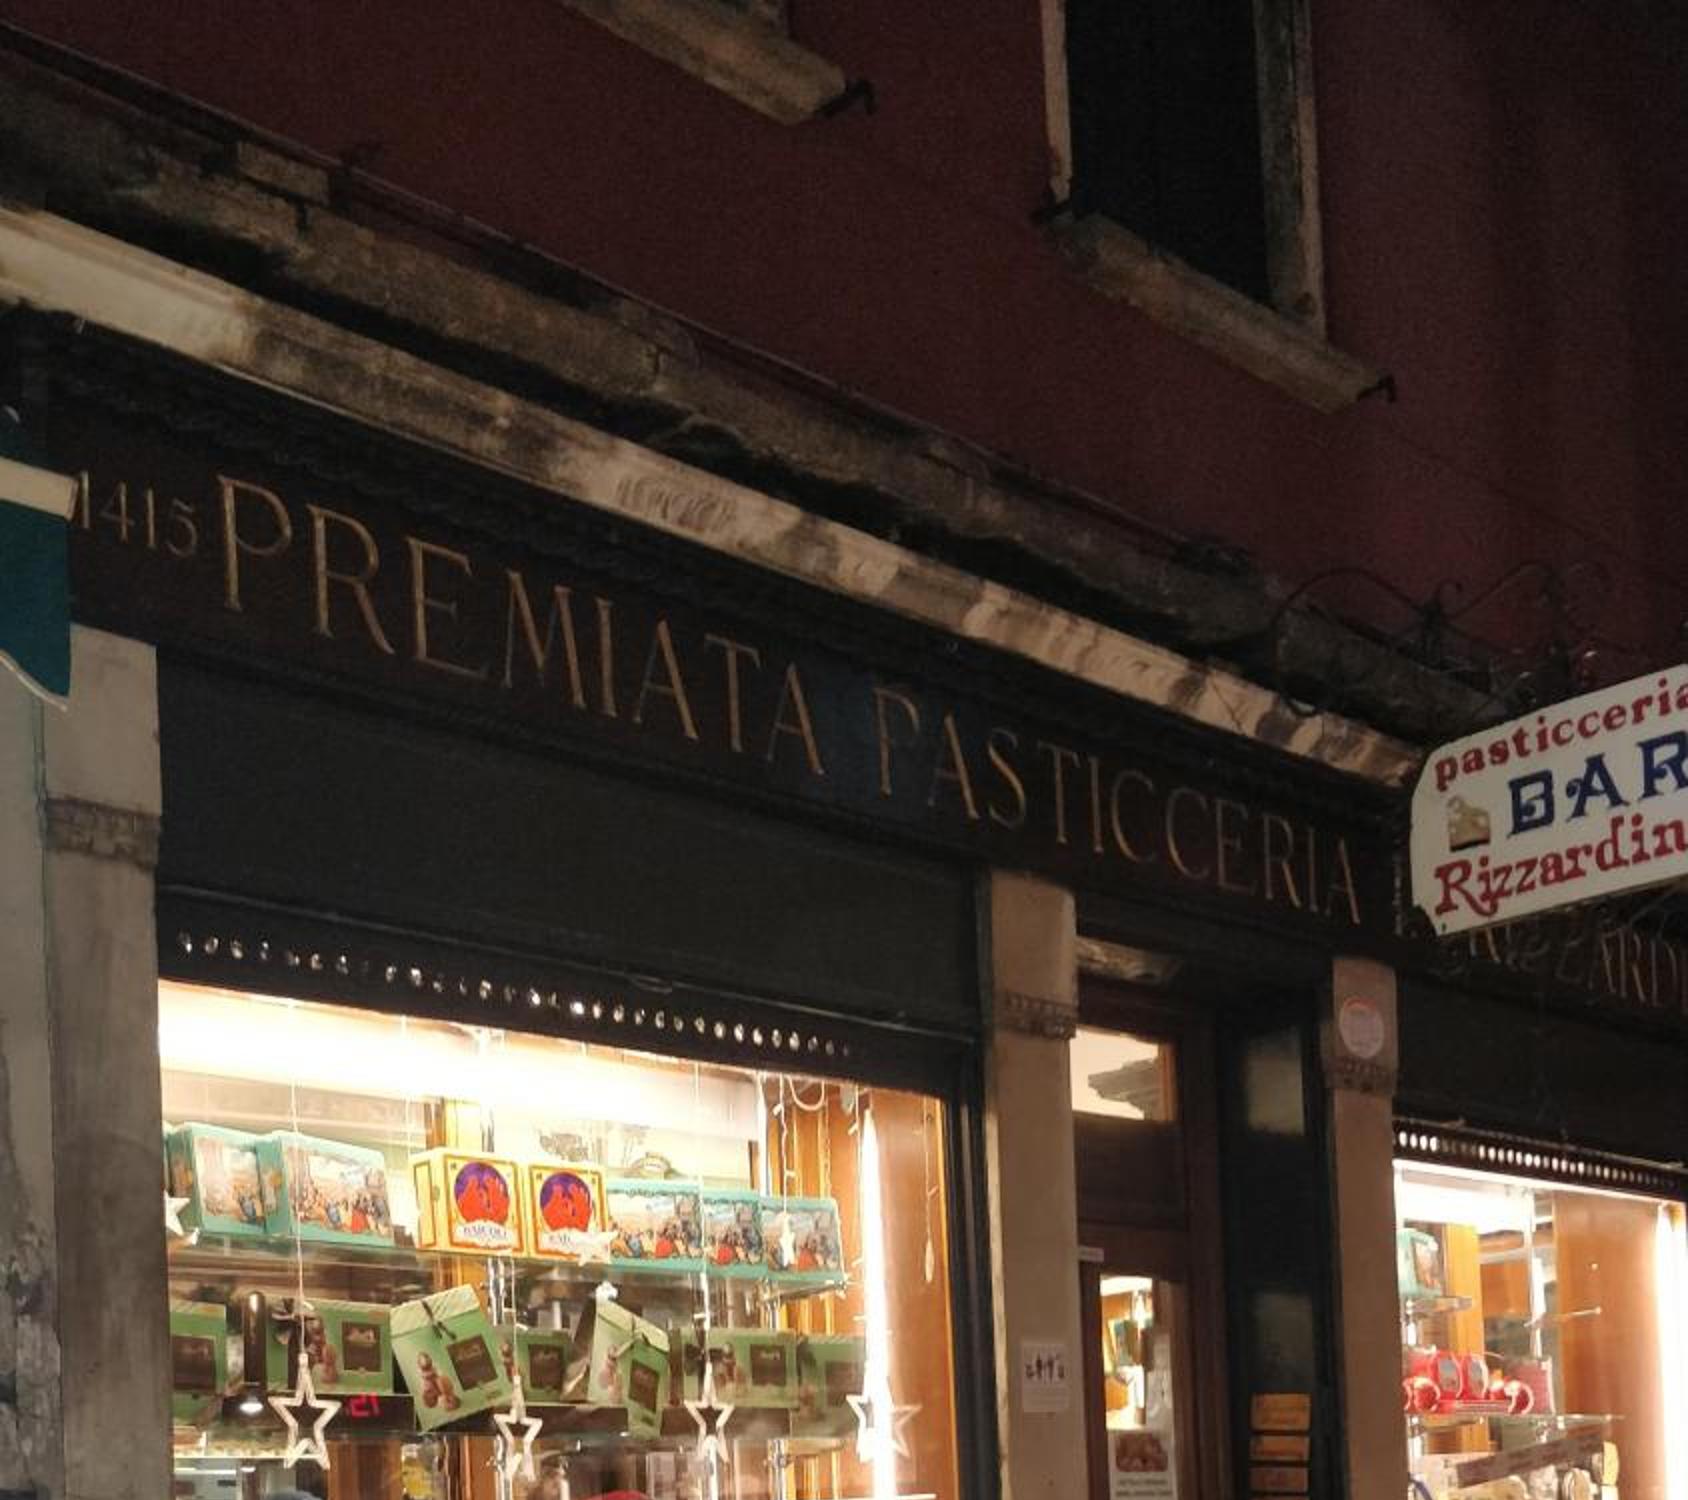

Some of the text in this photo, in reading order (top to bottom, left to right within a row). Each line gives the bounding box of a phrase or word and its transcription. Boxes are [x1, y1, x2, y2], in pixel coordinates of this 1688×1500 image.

[216, 473, 828, 778] PREMIATA
[873, 685, 1361, 925] PASTICCERIA
[1506, 730, 1688, 839] BAR
